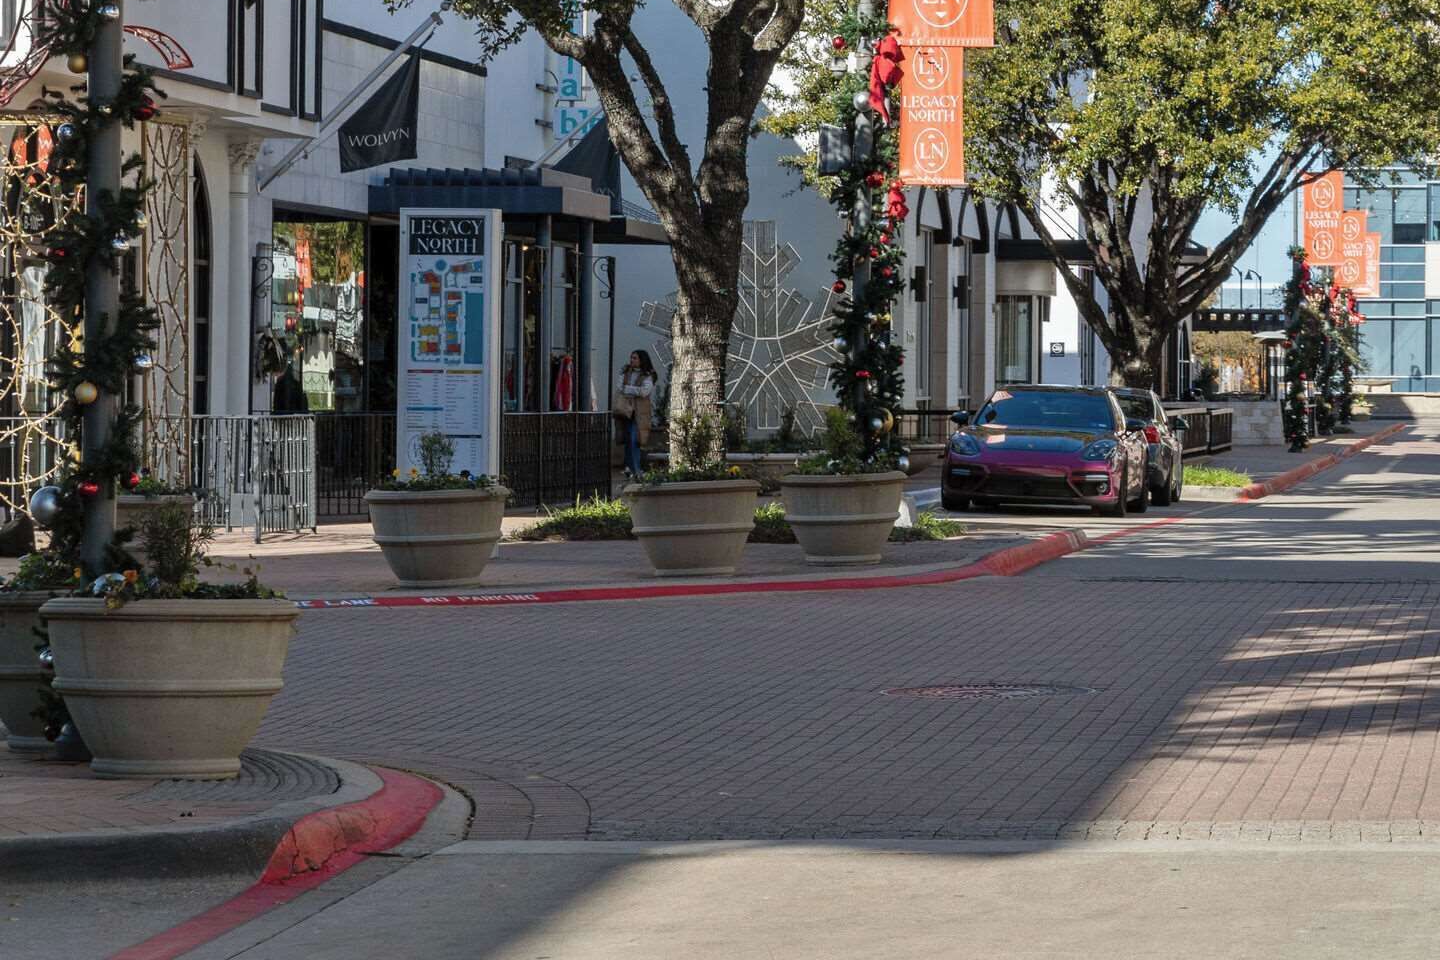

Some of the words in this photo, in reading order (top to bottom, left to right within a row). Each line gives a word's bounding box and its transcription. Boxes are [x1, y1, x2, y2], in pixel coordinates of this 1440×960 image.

[917, 55, 945, 77] LN
[903, 95, 959, 108] LEGACY
[909, 109, 954, 122] NORTH
[348, 127, 410, 147] WOLVYN
[920, 143, 943, 159] LN
[1315, 187, 1331, 198] LN
[1305, 210, 1341, 220] LEGACY
[410, 218, 483, 235] LEGACY
[417, 237, 477, 254] NORTH
[1315, 237, 1331, 250] LN
